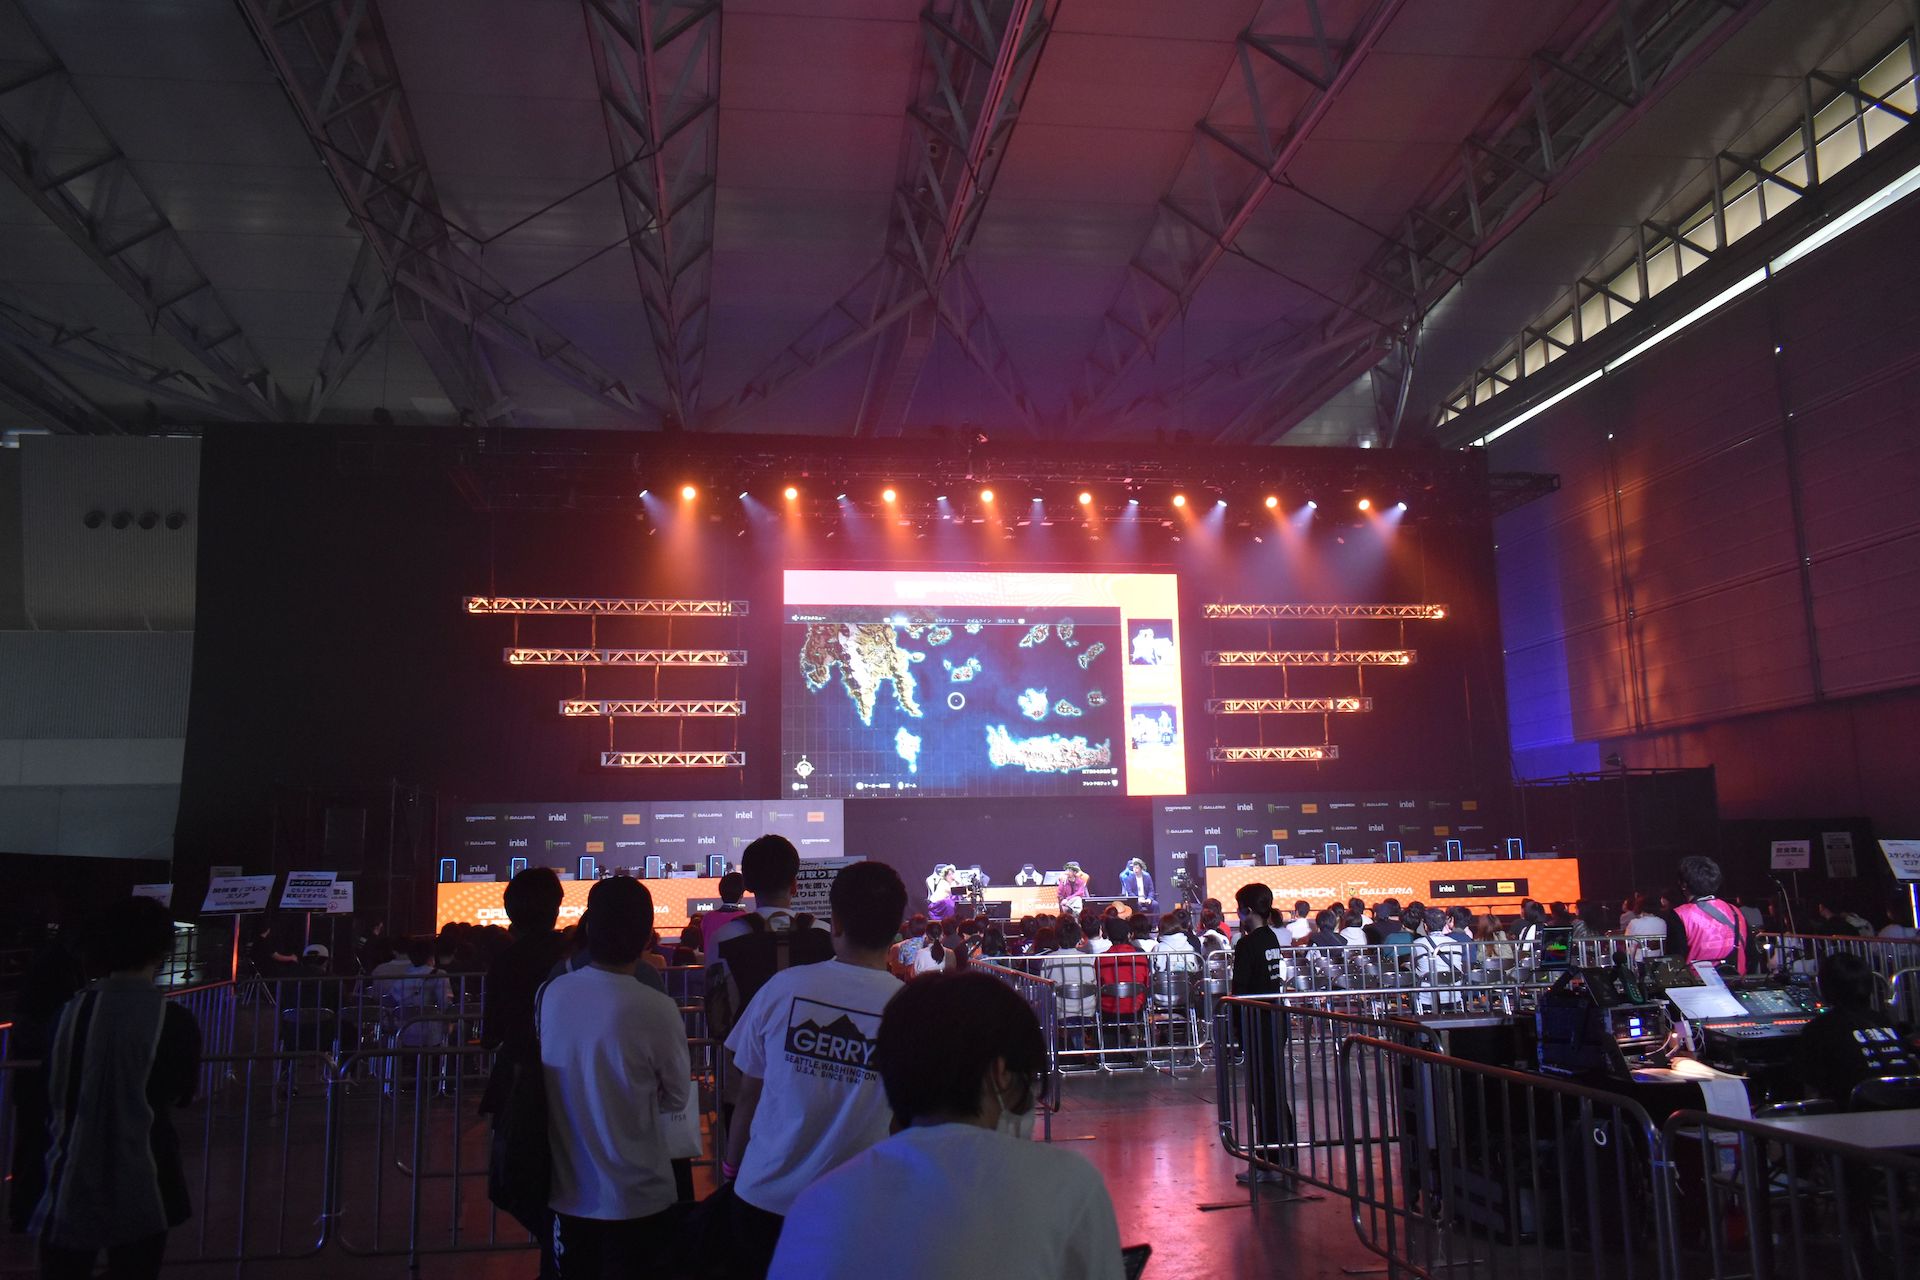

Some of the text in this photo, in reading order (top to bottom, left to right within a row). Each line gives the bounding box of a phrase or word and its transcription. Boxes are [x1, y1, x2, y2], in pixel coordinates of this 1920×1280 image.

[1237, 803, 1254, 811] intel
[1399, 800, 1415, 808] intel
[548, 813, 567, 821] intel
[735, 810, 753, 819] intel
[1204, 827, 1221, 835] intel
[1368, 824, 1384, 832] intel
[509, 839, 527, 847] intel
[698, 835, 716, 844] intel
[469, 864, 488, 872] intel
[1272, 887, 1337, 898] AMHACK
[1359, 886, 1413, 896] GALLERIA
[1439, 884, 1456, 893] intel
[696, 902, 713, 912] intel
[793, 1028, 876, 1065] GERRY
[820, 1070, 842, 1082] SINCE
